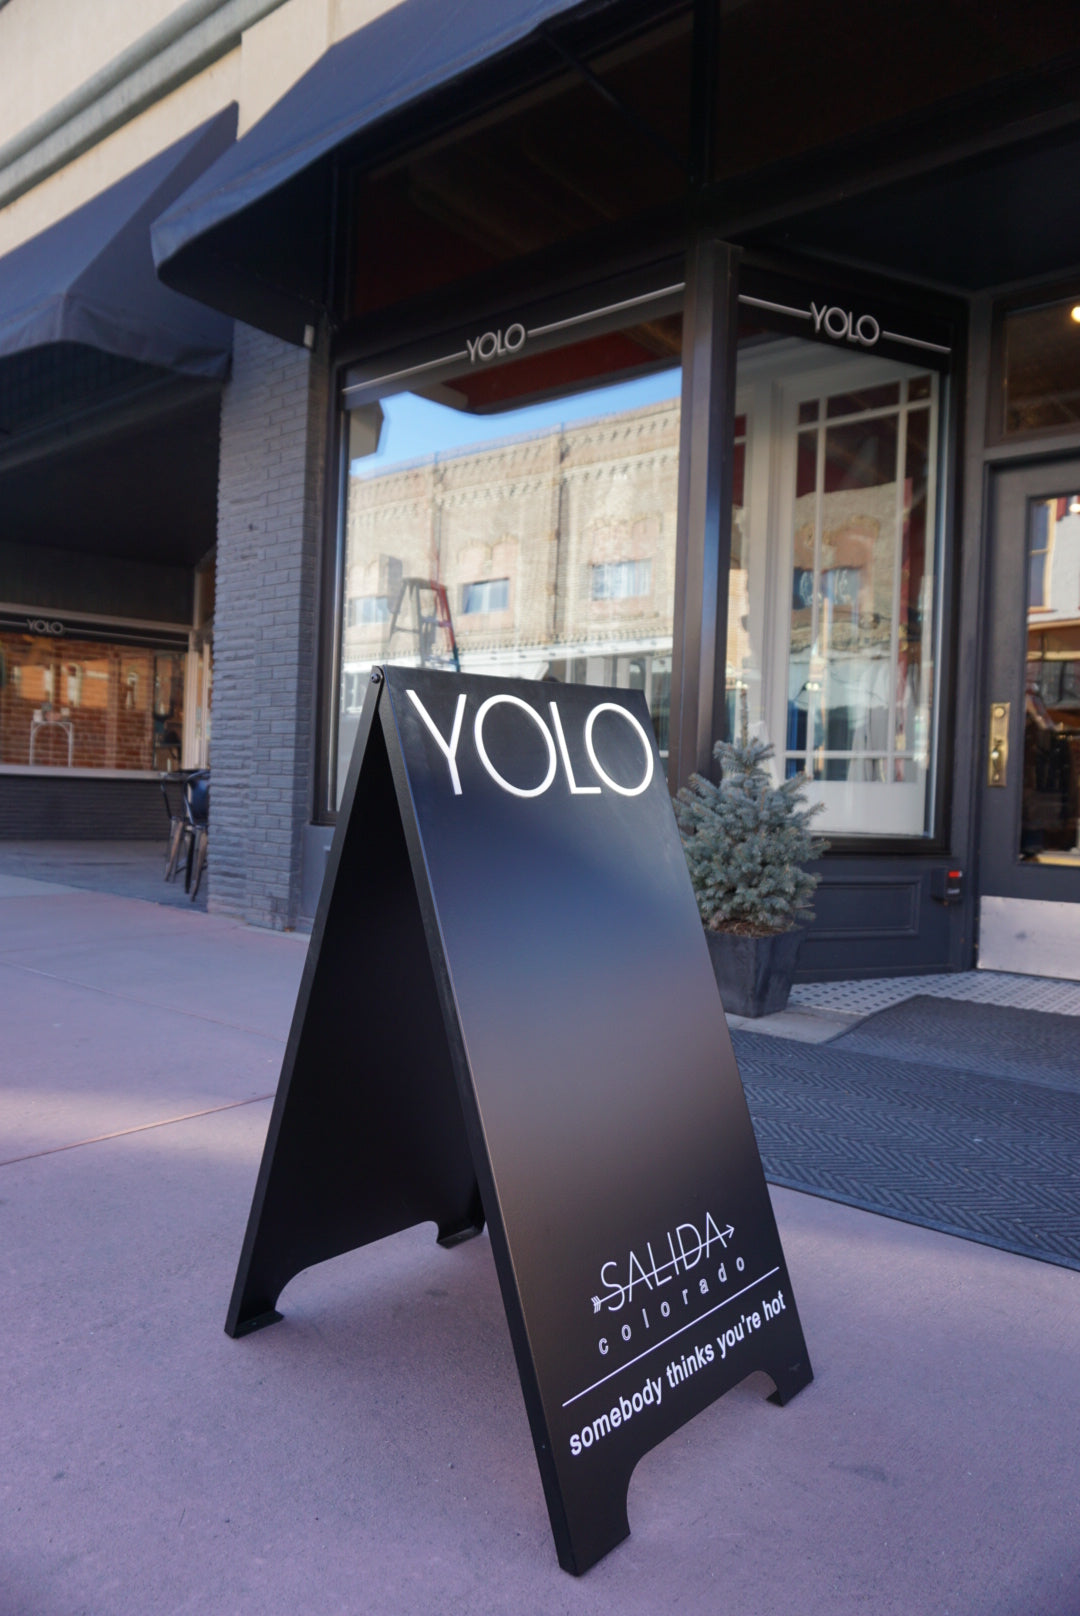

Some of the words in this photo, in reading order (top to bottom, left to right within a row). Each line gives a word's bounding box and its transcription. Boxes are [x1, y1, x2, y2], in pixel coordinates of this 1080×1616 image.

[466, 323, 526, 363] YOLO
[810, 301, 880, 346] YOLO
[26, 618, 64, 633] YOLO
[405, 689, 654, 797] YOLO
[598, 1257, 745, 1354] colorado
[600, 1212, 727, 1311] SALIDA
[569, 1377, 662, 1456] somebody
[666, 1343, 714, 1388] thinks
[717, 1315, 762, 1358] you're
[763, 1291, 786, 1322] hot
